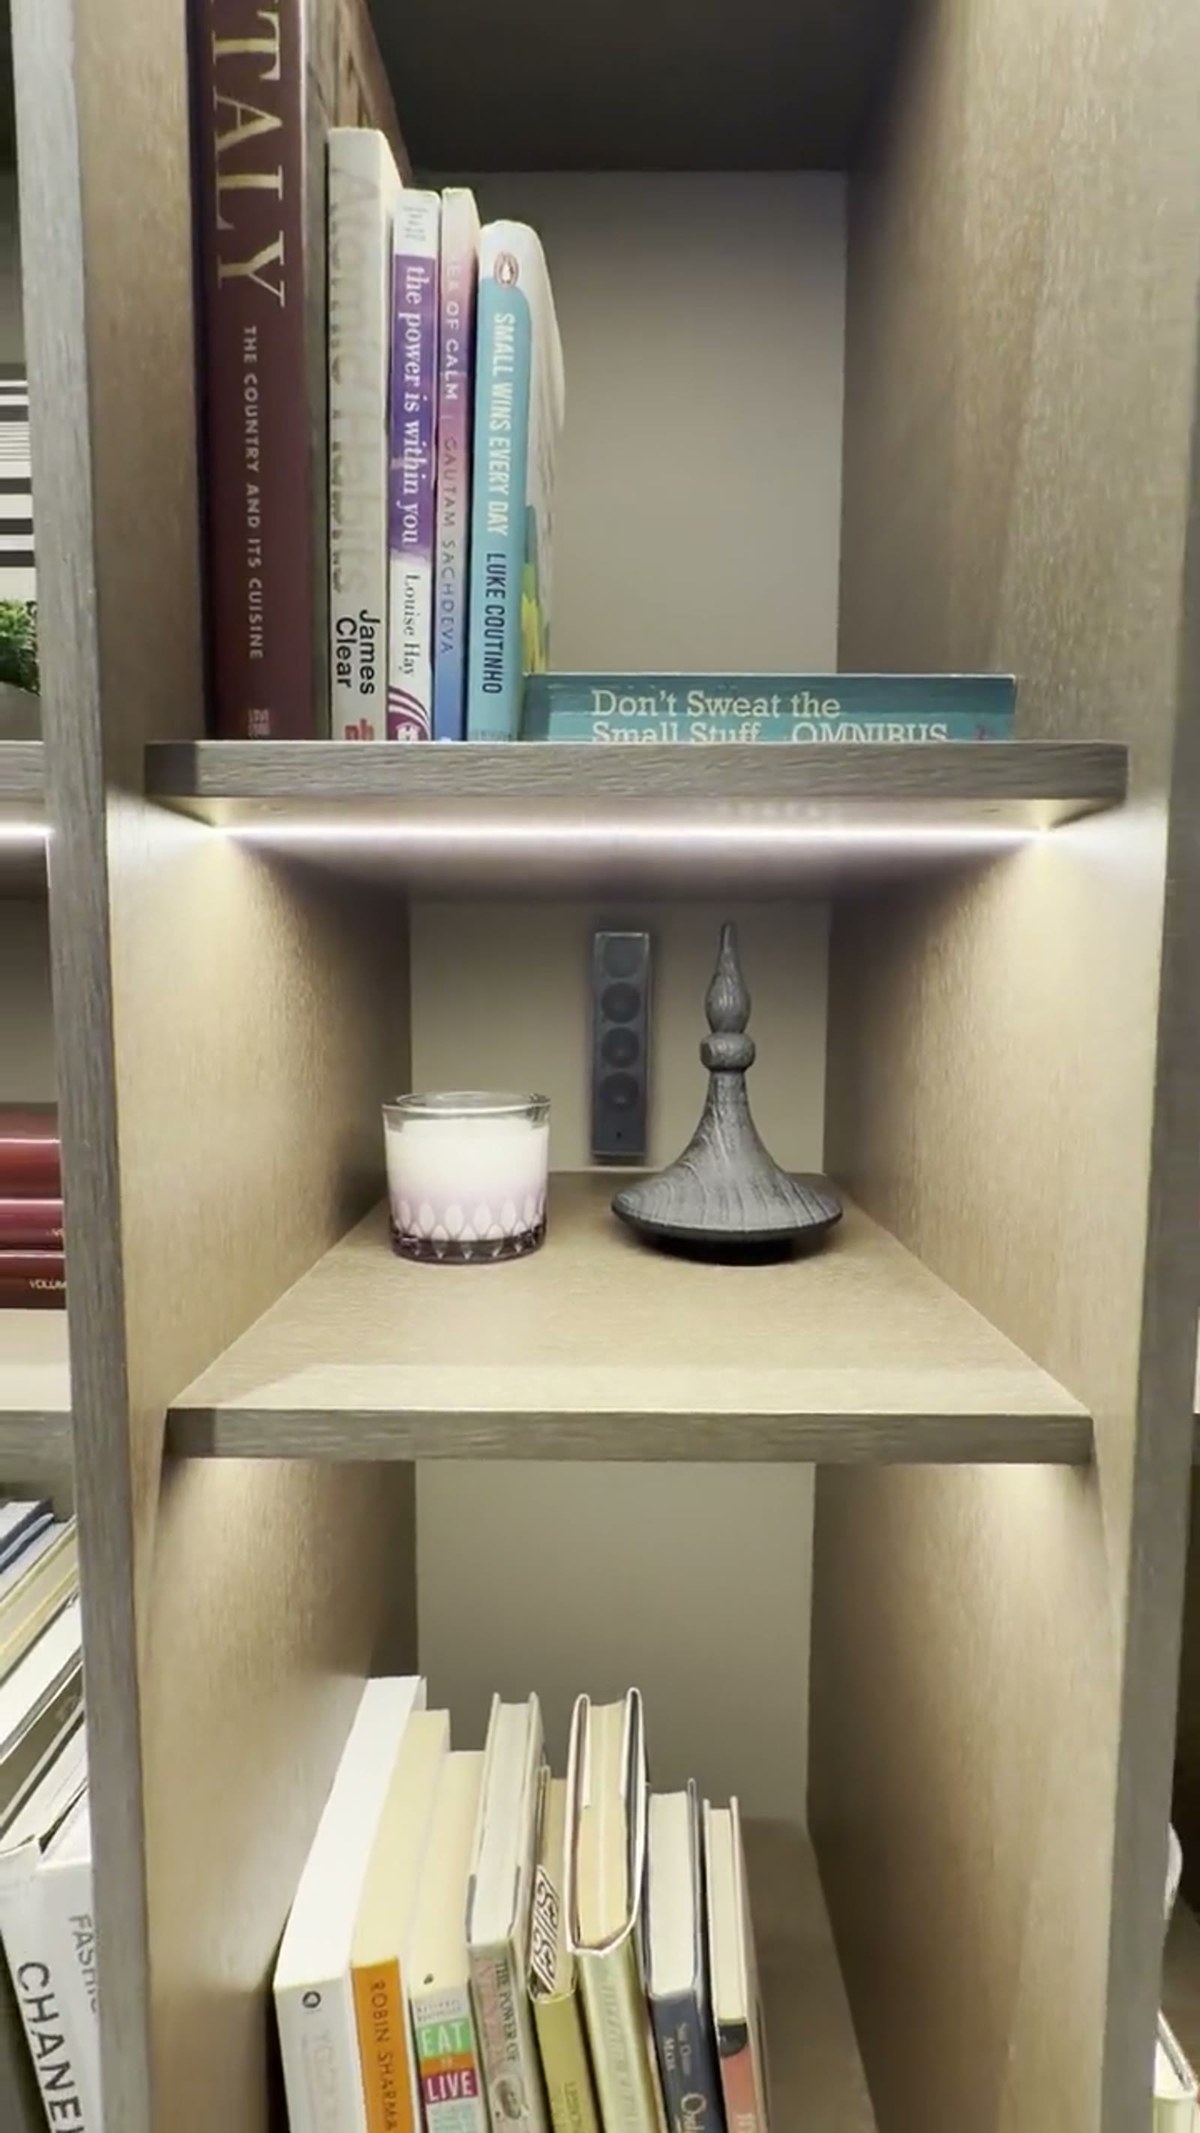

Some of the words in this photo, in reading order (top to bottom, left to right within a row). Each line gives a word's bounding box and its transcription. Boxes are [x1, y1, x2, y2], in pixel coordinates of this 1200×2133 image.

[211, 0, 285, 308] TALY
[405, 266, 430, 304] the
[446, 301, 460, 330] OF
[243, 325, 258, 363] THE
[398, 312, 422, 388] power
[445, 338, 460, 400] CALM
[492, 312, 516, 377] SMALL
[243, 373, 260, 472] COUNTRY
[404, 393, 428, 412] is
[489, 382, 514, 431] WINS
[403, 421, 427, 495] within
[443, 436, 457, 527] GAUTAM
[488, 437, 512, 496] EVERY
[246, 483, 261, 528] AND
[396, 501, 419, 545] you
[487, 501, 509, 537] DAY
[247, 538, 262, 568] ITS
[485, 553, 507, 599] LUKE
[249, 578, 264, 660] CUISINE
[403, 574, 421, 636] Louise
[441, 540, 456, 654] SACHDEVA
[336, 617, 357, 688] Clear
[359, 609, 381, 695] James
[398, 643, 420, 677] Hay
[482, 604, 506, 694] COUTINHO
[591, 690, 677, 717] Don't
[687, 690, 781, 718] Sweat
[791, 691, 841, 718] the
[592, 721, 678, 742] Small
[690, 721, 762, 742] Stuff
[28, 1279, 67, 1290] VOLUM
[69, 1914, 98, 2013] FASH
[370, 1979, 391, 2043] ROBIN
[500, 1992, 518, 2041] POWER
[421, 2021, 465, 2058] EAT
[377, 2051, 399, 2132] SHARMA
[427, 2070, 473, 2102] LIVE
